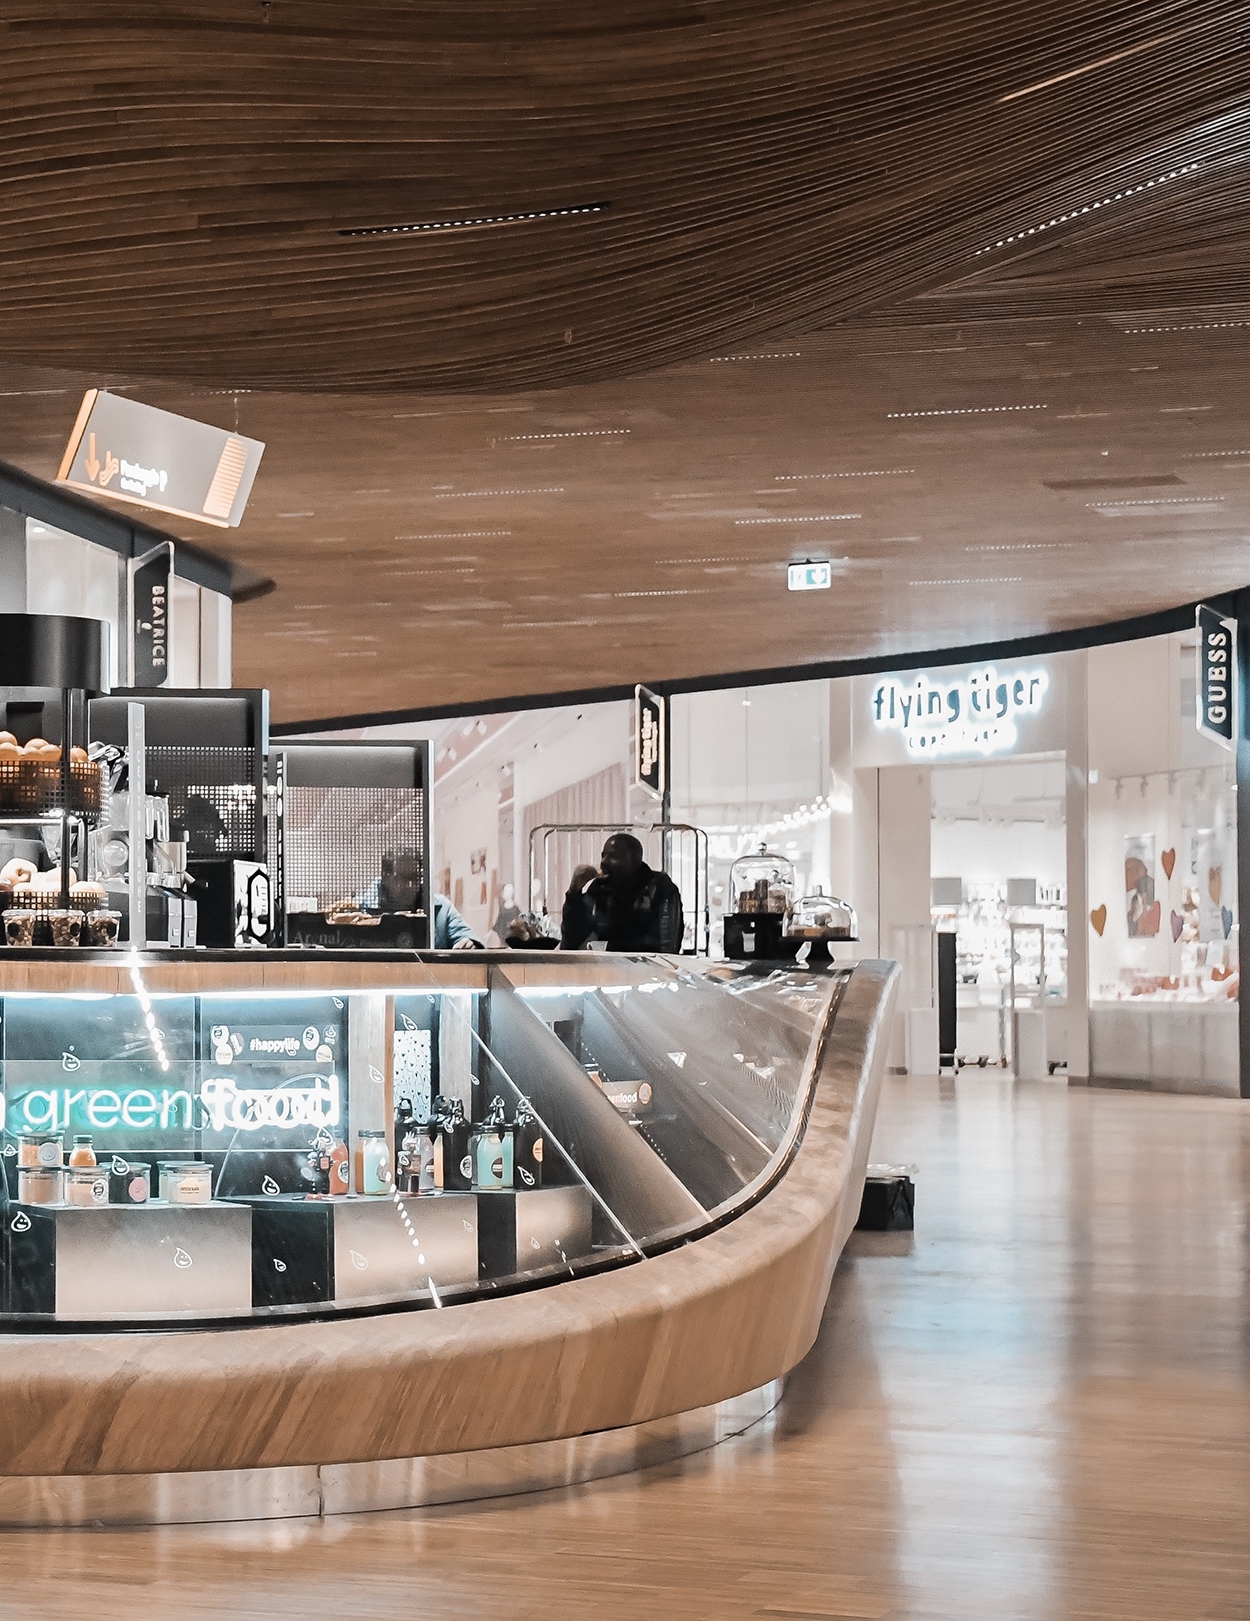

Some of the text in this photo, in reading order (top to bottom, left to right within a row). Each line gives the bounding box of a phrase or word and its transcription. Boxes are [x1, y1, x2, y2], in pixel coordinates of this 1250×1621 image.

[151, 585, 166, 667] BEATRICE
[873, 673, 1040, 728] flying tiger
[1207, 632, 1227, 724] GUESS
